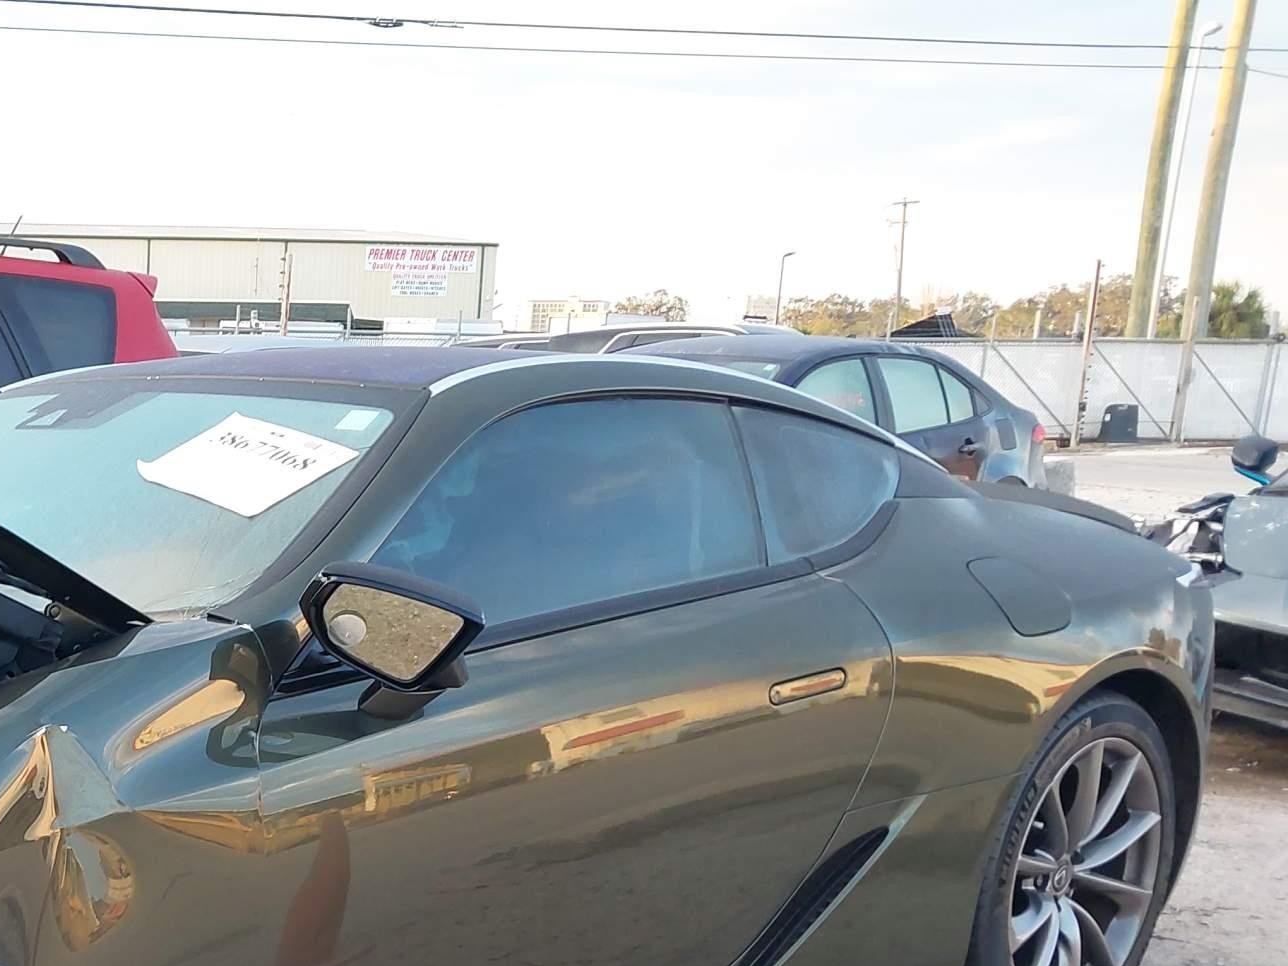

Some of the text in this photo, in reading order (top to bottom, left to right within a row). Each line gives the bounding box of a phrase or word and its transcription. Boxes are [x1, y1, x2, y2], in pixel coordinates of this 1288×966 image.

[368, 248, 476, 262] PREMIER TRUCK CENTER
